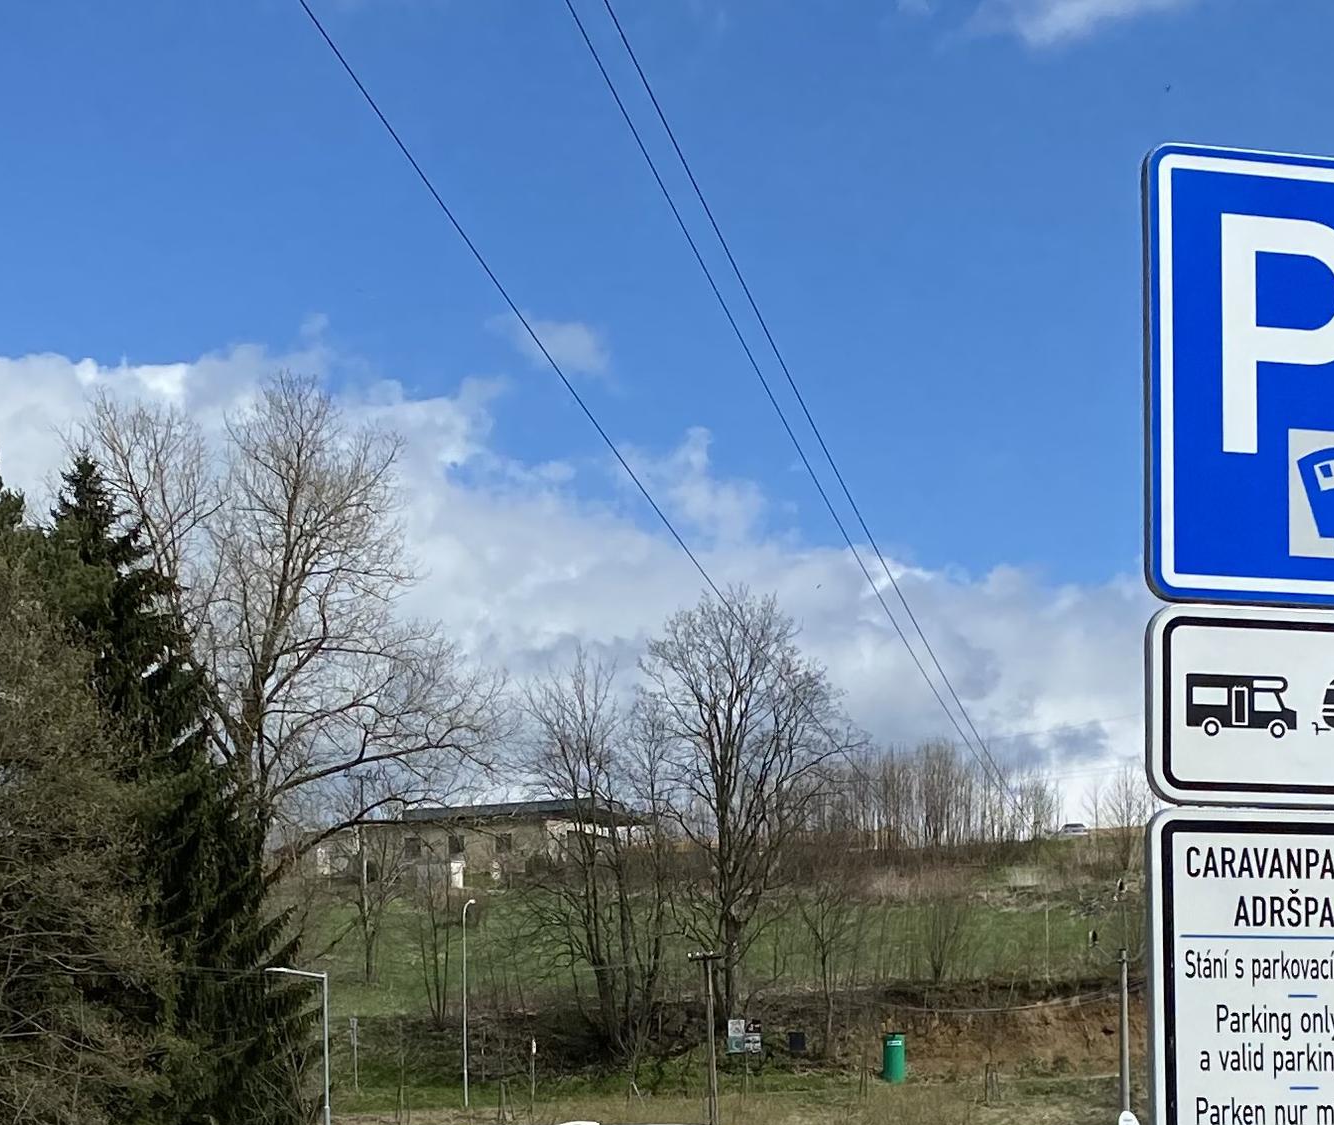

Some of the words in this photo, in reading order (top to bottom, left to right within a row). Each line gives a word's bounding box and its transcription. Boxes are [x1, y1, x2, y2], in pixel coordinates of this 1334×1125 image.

[1185, 948, 1229, 979] Stání
[1234, 957, 1245, 979] s
[1216, 1004, 1292, 1042] Parking
[1199, 1050, 1211, 1072] a
[1218, 1042, 1264, 1072] valid
[1196, 1096, 1266, 1125] Parken
[1274, 1104, 1308, 1125] nur
